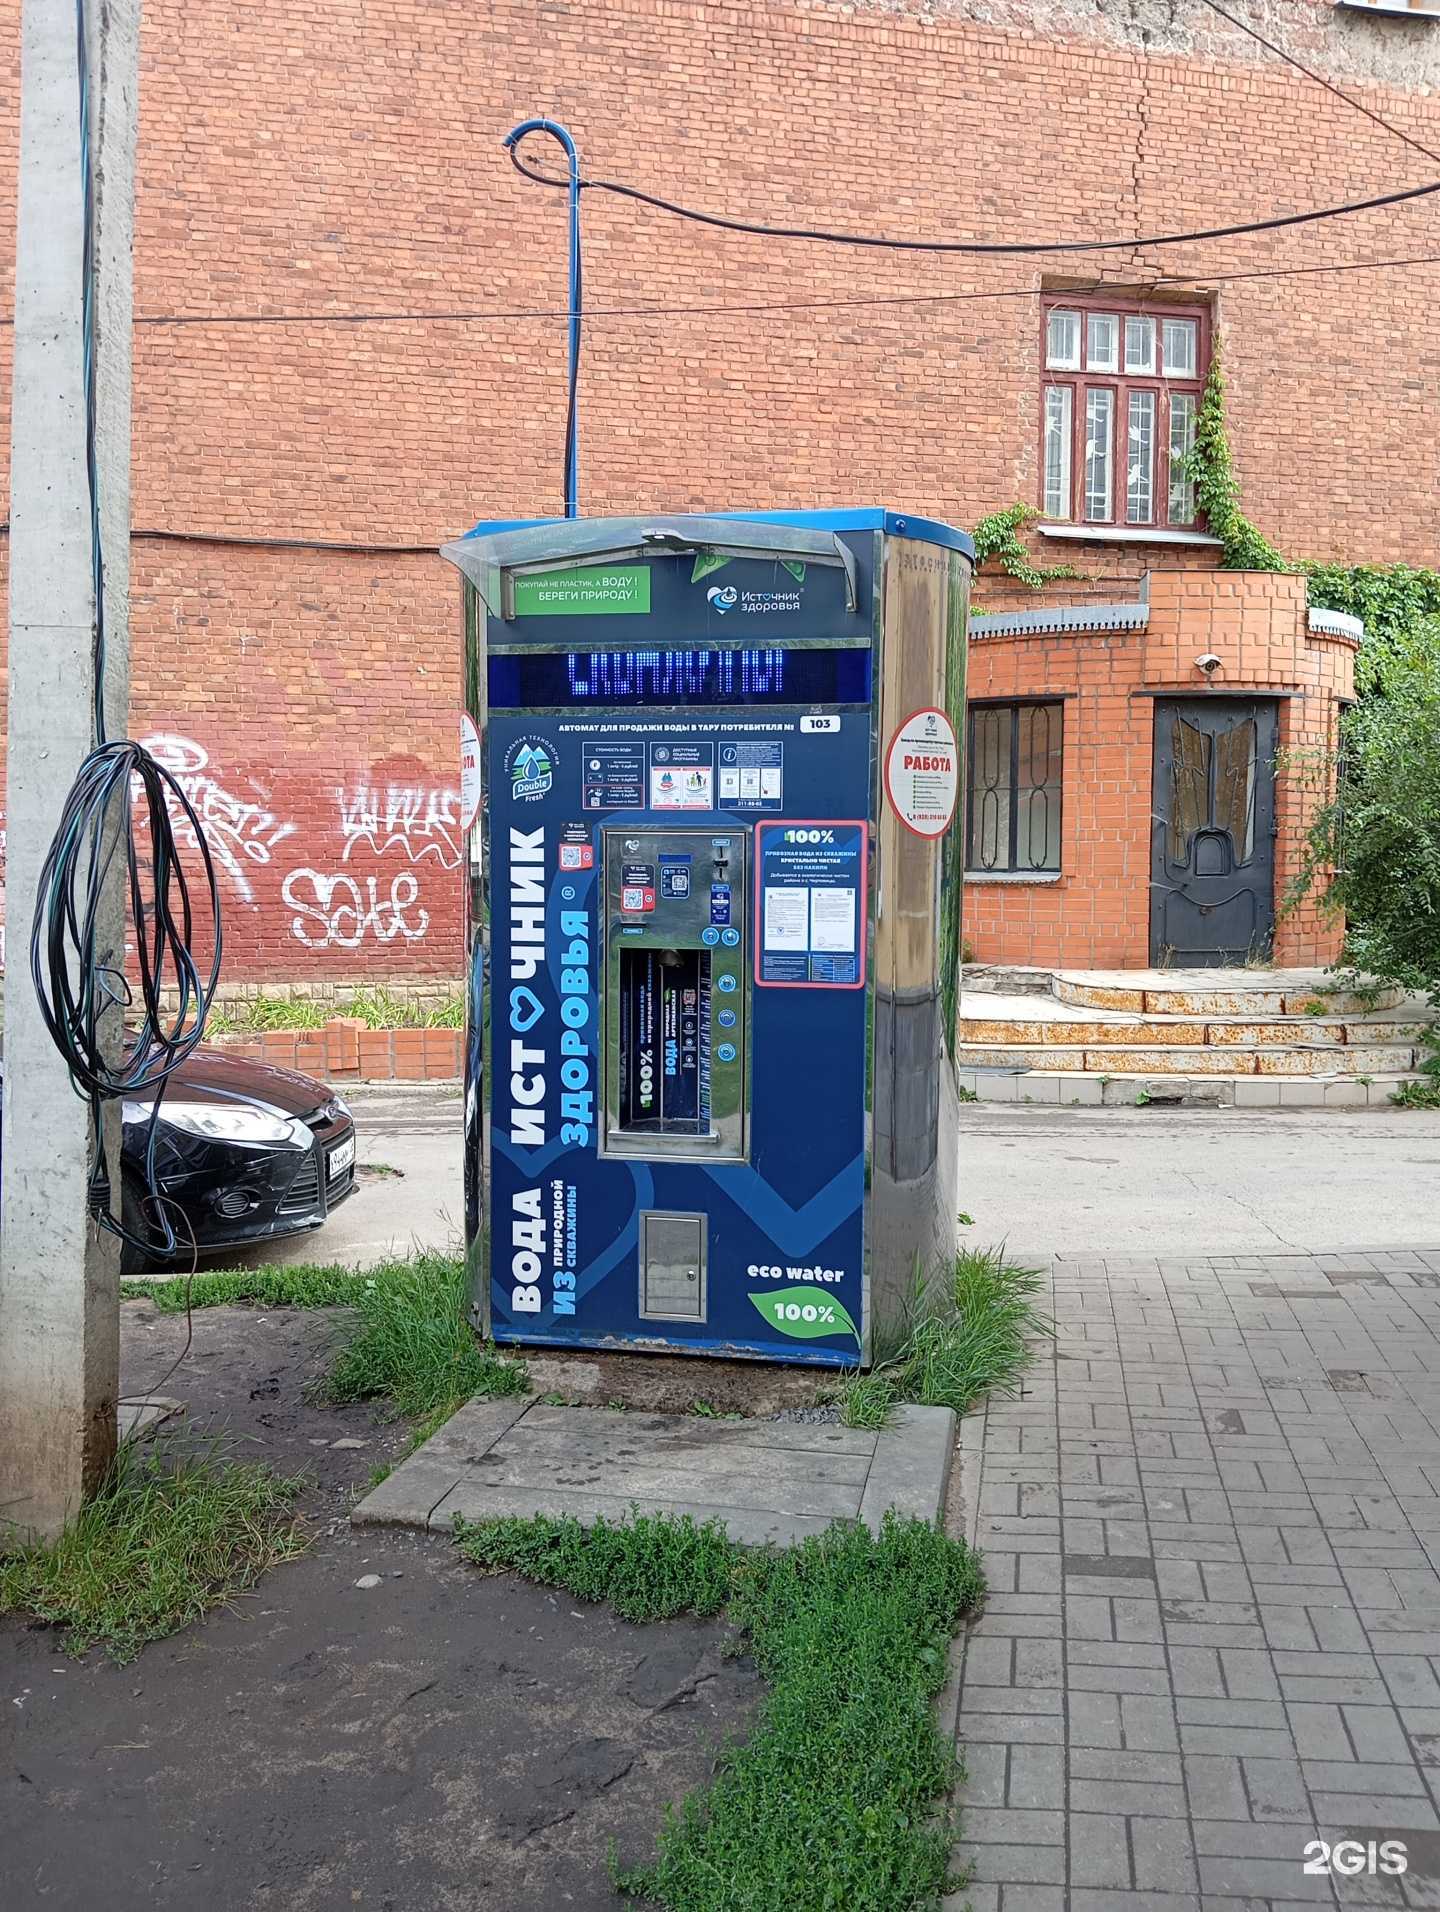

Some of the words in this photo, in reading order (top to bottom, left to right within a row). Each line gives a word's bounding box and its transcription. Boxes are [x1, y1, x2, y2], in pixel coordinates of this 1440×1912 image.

[515, 580, 548, 589] ПОКУПАЙ
[560, 580, 594, 588] ПЛАСТИК,
[602, 577, 633, 587] ВОДУ
[538, 591, 578, 601] БЕРЕГИ
[580, 590, 633, 600] ПРИРОДУ
[558, 724, 600, 732] АВТОМАТ
[600, 724, 617, 732] ДЛЯ
[618, 724, 663, 732] ПРОДАЖИ
[664, 724, 690, 732] ВОДЫ
[720, 723, 783, 731] ПОТРЕБИТЕЛЯ
[809, 719, 831, 729] 103
[503, 735, 527, 772] УНИКАЛЬНАЯ
[529, 735, 560, 765] ТЕХНОЛОГИЯ
[903, 755, 952, 772] РАБОТА
[517, 779, 547, 793] Double
[525, 793, 543, 802] Fresh
[787, 830, 834, 844] 100%
[560, 911, 593, 1148] ЗДОРОВЬЯ
[665, 1039, 678, 1076] ВОДА
[640, 1049, 653, 1105] 100%
[551, 1179, 564, 1268] ПРИРОДНОЙ
[566, 1185, 577, 1268] СКВАЖИНЫ
[511, 1187, 547, 1313] ВОДА
[747, 1264, 783, 1279] eco
[785, 1265, 845, 1283] water
[552, 1270, 577, 1316] ИЗ
[774, 1302, 835, 1324] 100%
